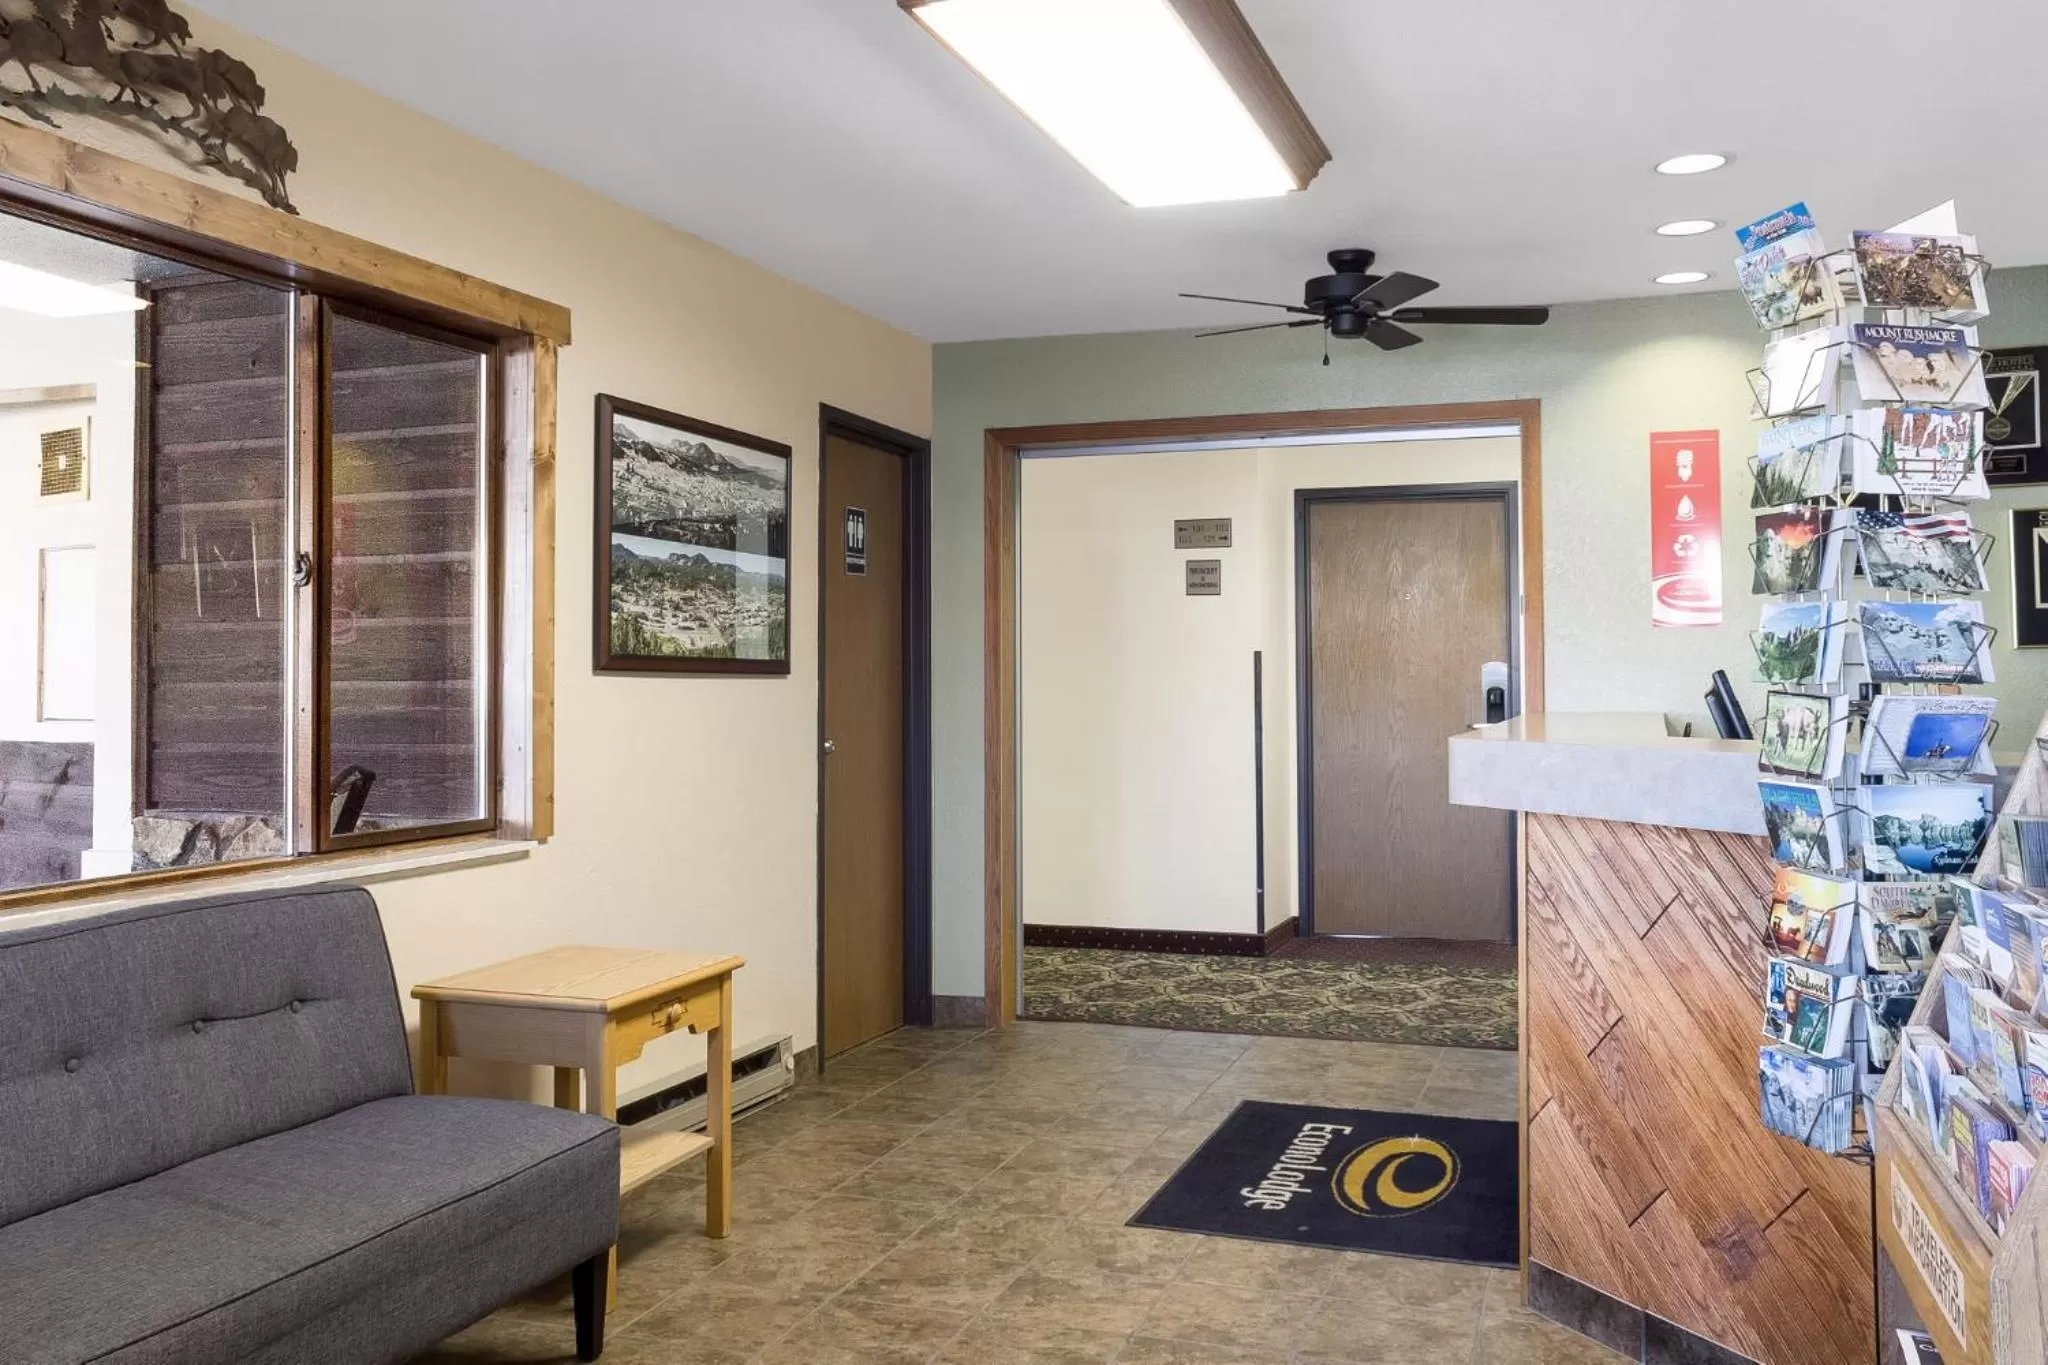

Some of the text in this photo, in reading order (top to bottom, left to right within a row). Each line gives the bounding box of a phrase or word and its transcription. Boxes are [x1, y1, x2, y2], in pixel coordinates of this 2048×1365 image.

[1864, 326, 1957, 345] MOUNT RUSHMORE
[1873, 886, 1909, 898] SOUTH
[1786, 966, 1829, 996] Deadwood
[1907, 1223, 1965, 1338] INFORMATION
